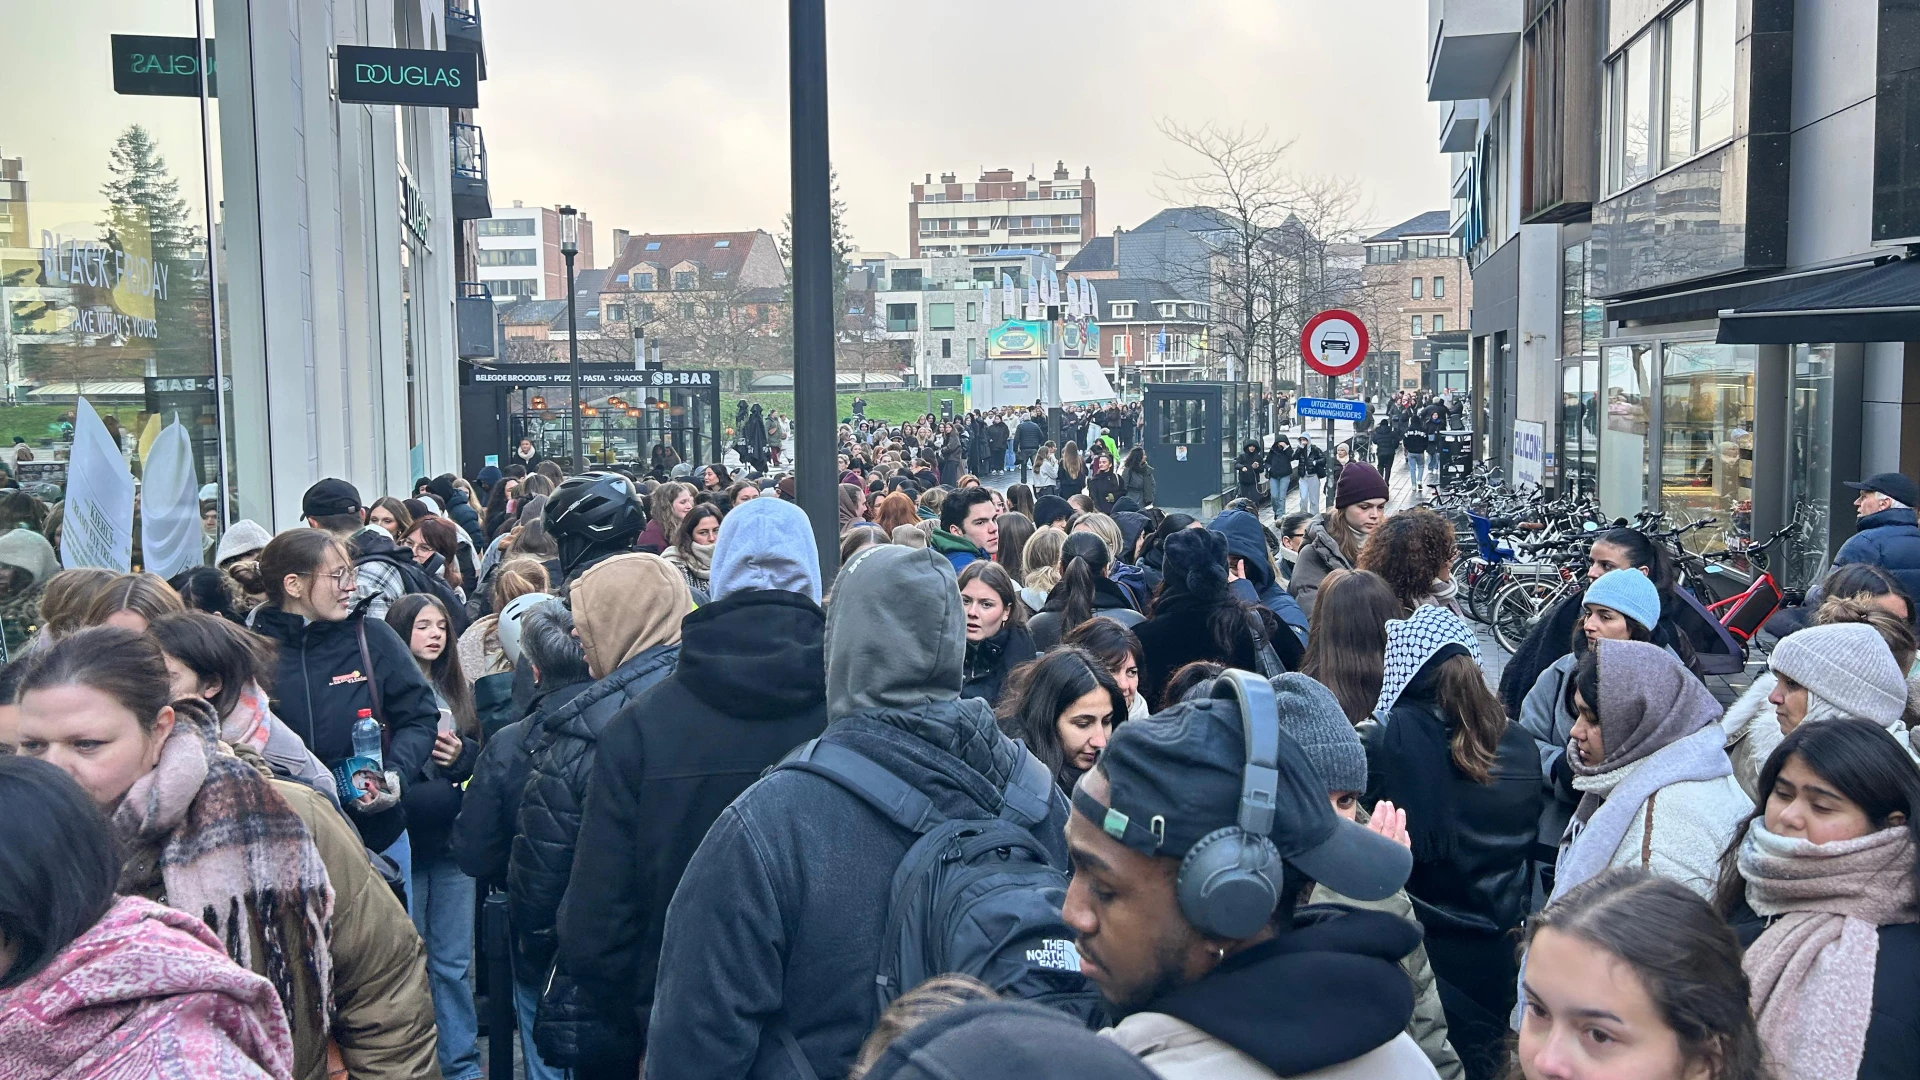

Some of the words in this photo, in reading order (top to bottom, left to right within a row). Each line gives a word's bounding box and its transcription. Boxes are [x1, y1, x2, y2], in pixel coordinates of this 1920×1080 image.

[356, 64, 460, 87] DOUGLAS
[41, 229, 110, 289] BLACK
[115, 249, 168, 300] FRIDAY
[69, 308, 94, 332] TAKE
[97, 311, 130, 336] WHAT'S
[132, 316, 157, 338] YOURS
[1310, 400, 1353, 410] UITGEZONDERD
[1300, 407, 1362, 419] VERGUNNINGHOUDERS
[1042, 939, 1064, 950] THE
[1026, 949, 1064, 961] NORTH
[1039, 960, 1065, 969] FACE
